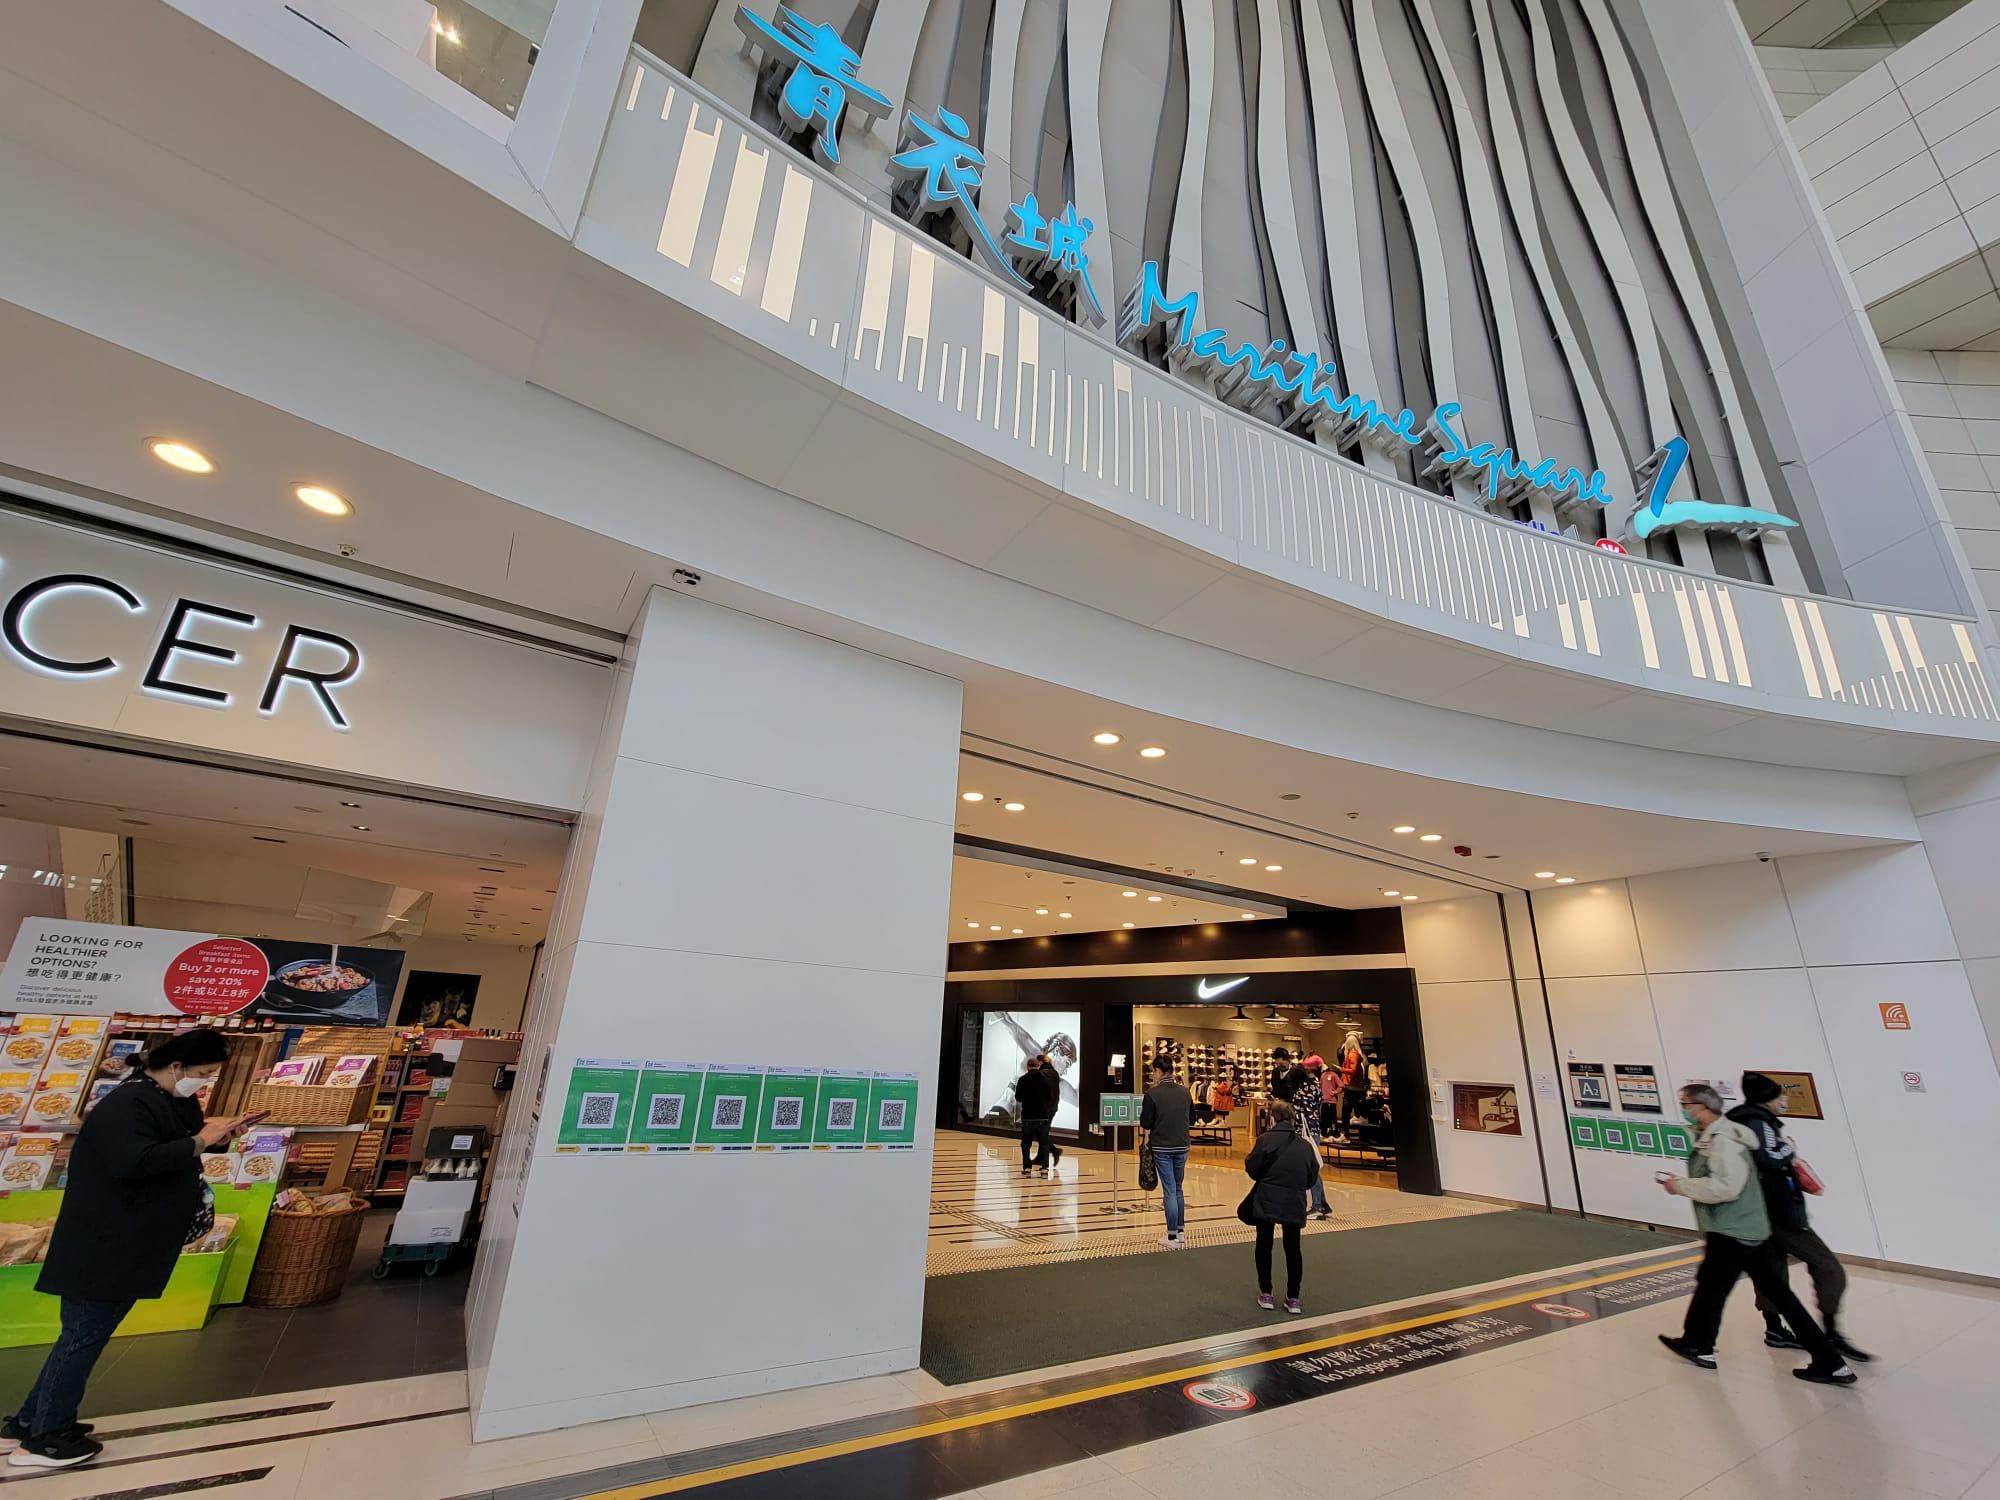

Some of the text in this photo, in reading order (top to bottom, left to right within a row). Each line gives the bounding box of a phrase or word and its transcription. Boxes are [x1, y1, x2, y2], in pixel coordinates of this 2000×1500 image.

[738, 5, 1105, 317] 青衣城
[1141, 260, 1614, 504] Maritime Square
[40, 933, 144, 949] LOOKING FOR
[35, 945, 108, 958] HEALTHIER
[30, 957, 98, 969] OPTIONS?
[178, 962, 260, 976] Buy 2 or more
[188, 976, 243, 986] save 20%
[172, 985, 251, 998] 2件或以上8折
[1582, 1082, 1600, 1096] A2
[1312, 1372, 1341, 1384] No
[1335, 1357, 1403, 1377] baggage
[1400, 1344, 1444, 1361] trolley
[1437, 1335, 1484, 1351] beyond
[1477, 1331, 1502, 1341] this
